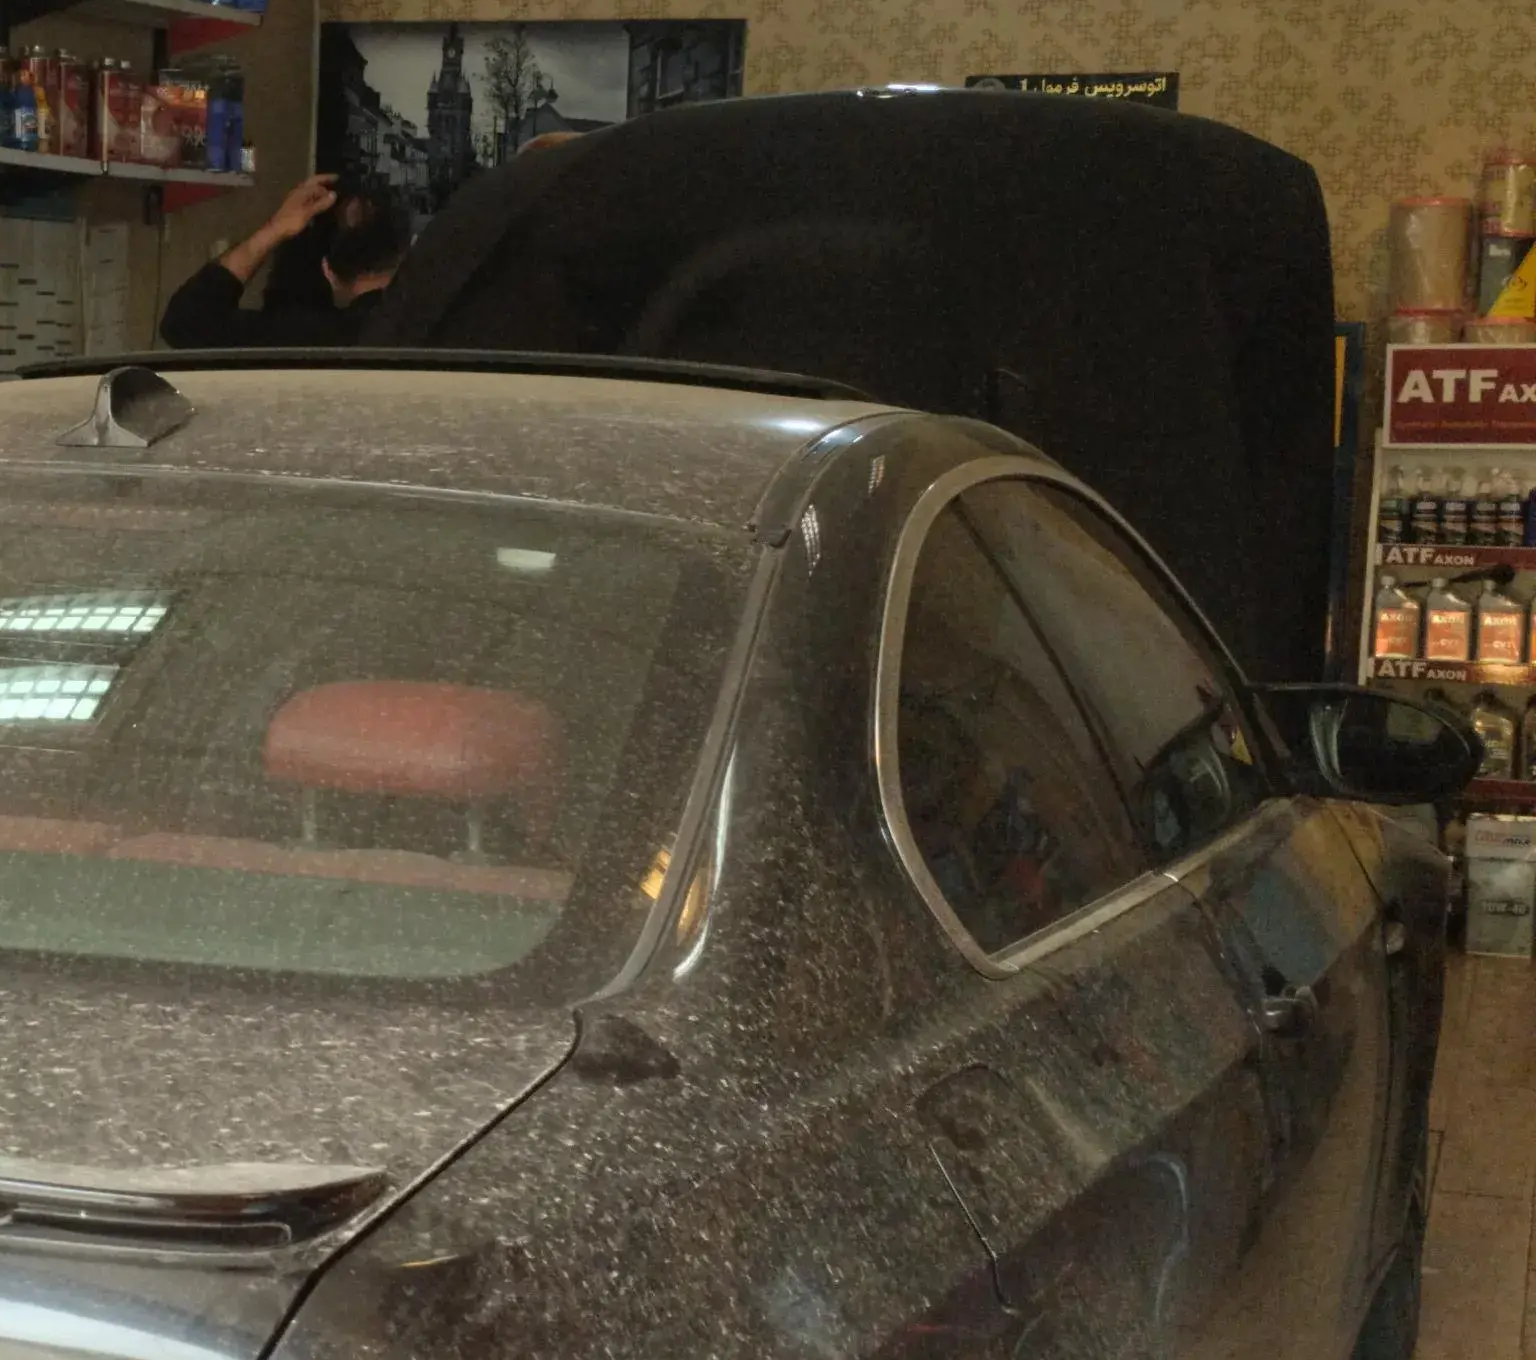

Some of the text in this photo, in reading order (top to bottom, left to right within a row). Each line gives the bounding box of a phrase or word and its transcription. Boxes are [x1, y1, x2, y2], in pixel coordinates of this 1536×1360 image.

[1084, 76, 1167, 98] اتوسرویس
[1397, 369, 1498, 403] ATF
[1386, 546, 1475, 566] ATF AXON
[1378, 659, 1467, 681] ATF AXON
